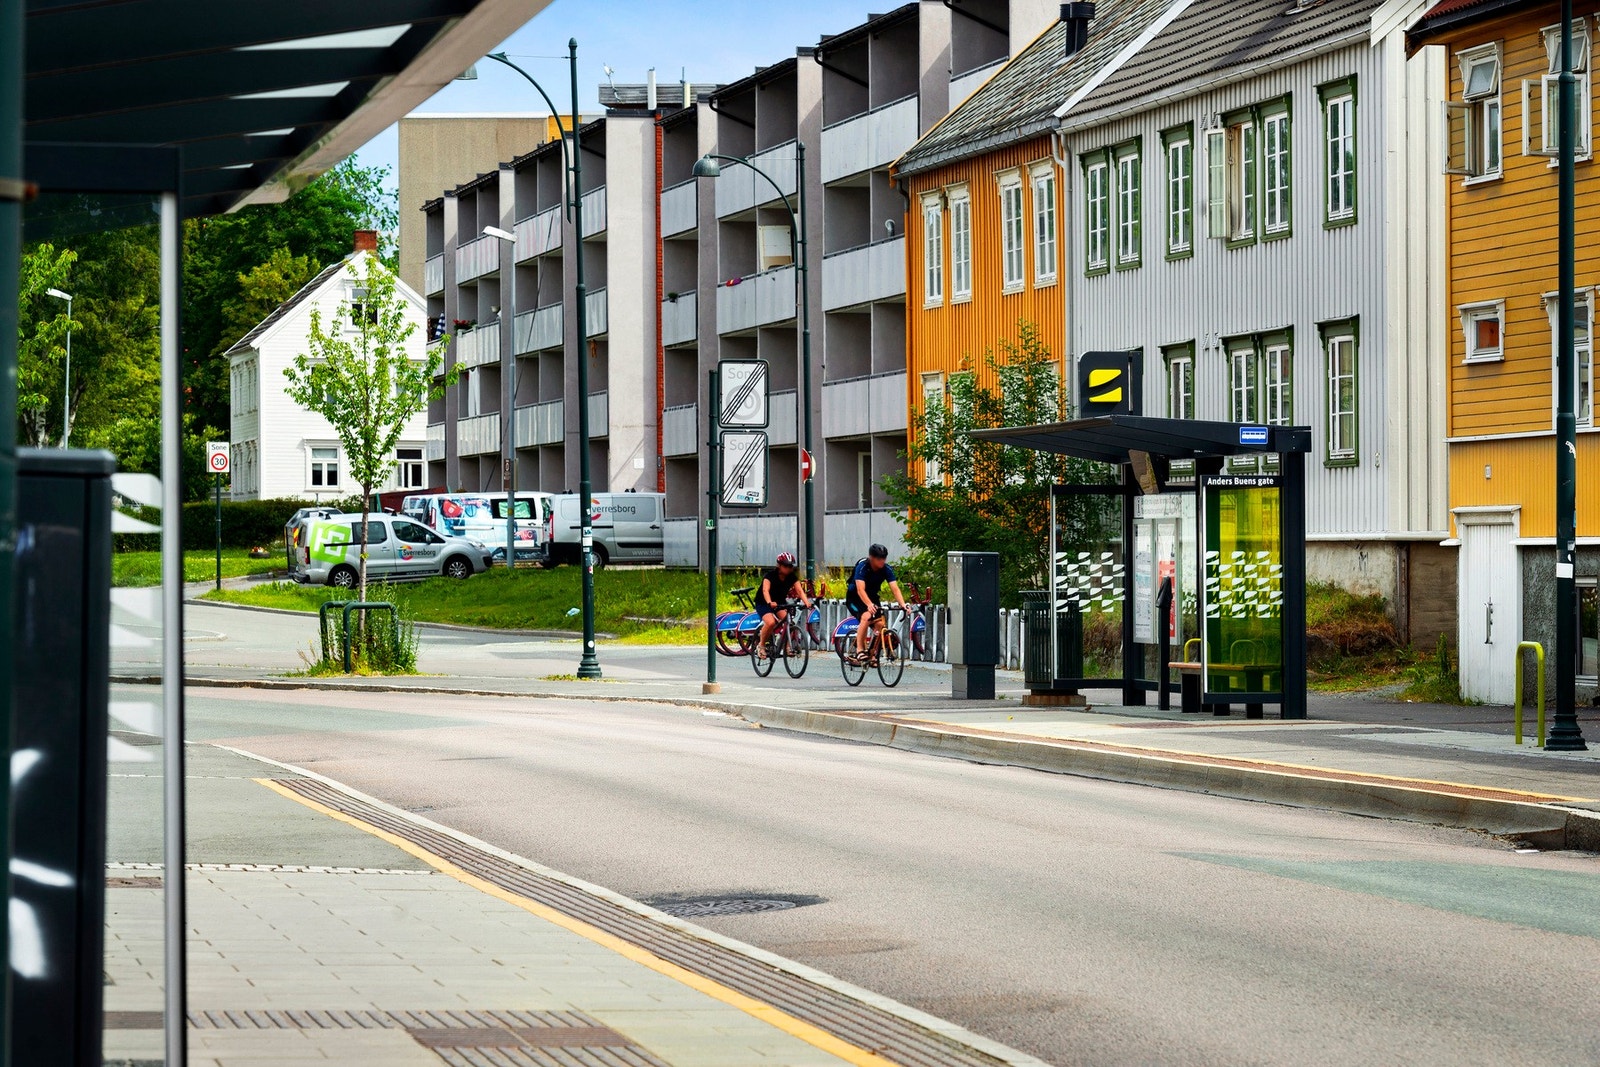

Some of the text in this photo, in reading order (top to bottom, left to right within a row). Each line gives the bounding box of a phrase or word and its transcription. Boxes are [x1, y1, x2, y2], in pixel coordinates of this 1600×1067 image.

[728, 367, 752, 379] Son
[211, 443, 227, 451] Sone
[730, 439, 751, 451] Son
[214, 457, 225, 466] 30
[1207, 477, 1274, 487] Anders Buens gate
[591, 505, 636, 515] verresborg
[403, 548, 436, 557] Sverresborg
